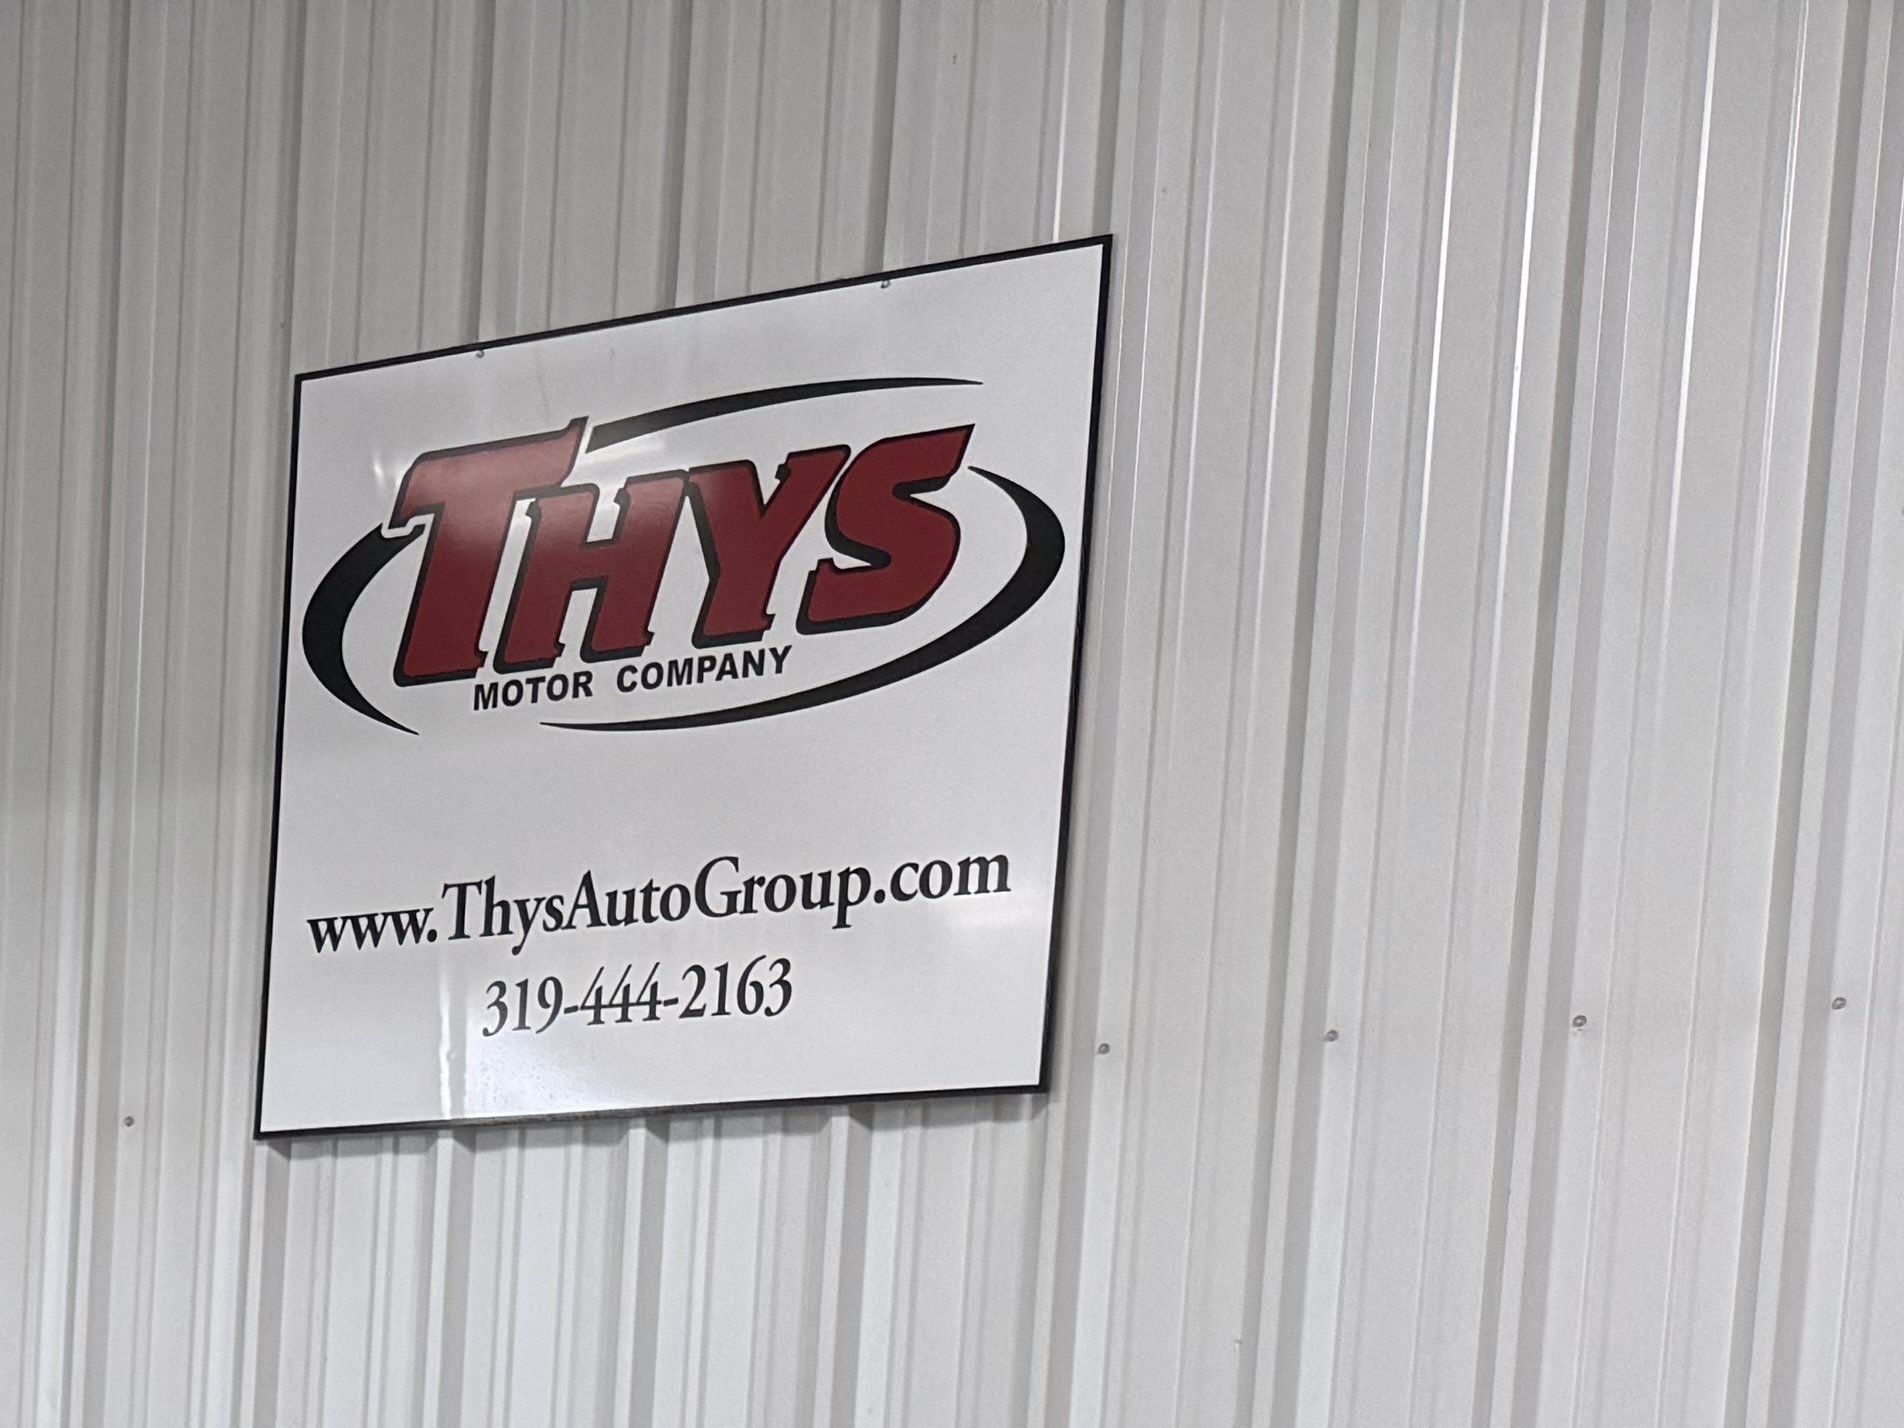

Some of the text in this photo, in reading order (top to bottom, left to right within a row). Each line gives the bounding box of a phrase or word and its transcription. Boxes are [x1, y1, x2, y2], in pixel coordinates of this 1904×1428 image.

[389, 416, 975, 688] THYS
[472, 645, 793, 713] MOTOR COMPANY
[307, 849, 1012, 956] www.ThysAutoGroup.com
[482, 955, 794, 1038] 319-444-2163
